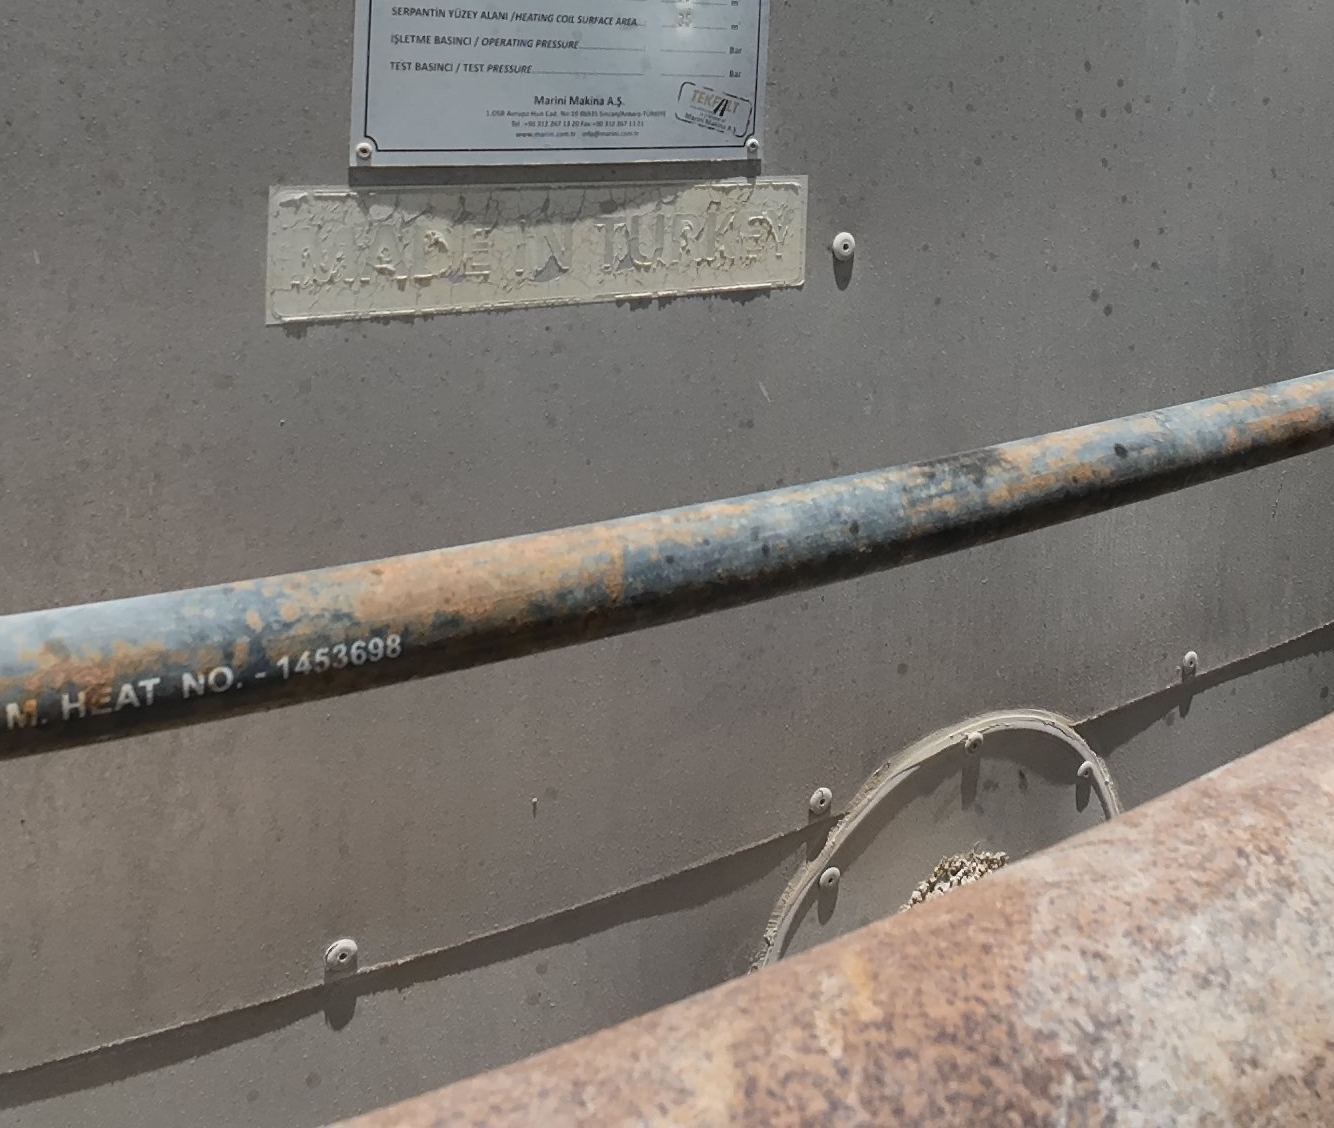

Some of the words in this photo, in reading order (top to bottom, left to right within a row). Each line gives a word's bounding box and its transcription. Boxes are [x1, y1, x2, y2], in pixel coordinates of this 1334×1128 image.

[448, 8, 478, 20] YÜZEY
[480, 11, 508, 20] ALANI
[556, 14, 575, 25] COIL
[577, 15, 613, 26] SURFACE
[616, 17, 637, 27] AREA
[434, 36, 472, 46] BASINCI
[481, 37, 533, 49] OPERATING
[535, 39, 579, 50] PRESSURE
[390, 61, 412, 71] TEST
[415, 62, 453, 72] BASINCI
[463, 63, 485, 73] TEST
[486, 64, 533, 74] PRESSURE
[729, 70, 742, 78] Bar
[534, 95, 566, 105] Marini
[569, 95, 604, 106] Makina
[594, 205, 794, 276] TURKEY
[61, 675, 161, 720] HEAT
